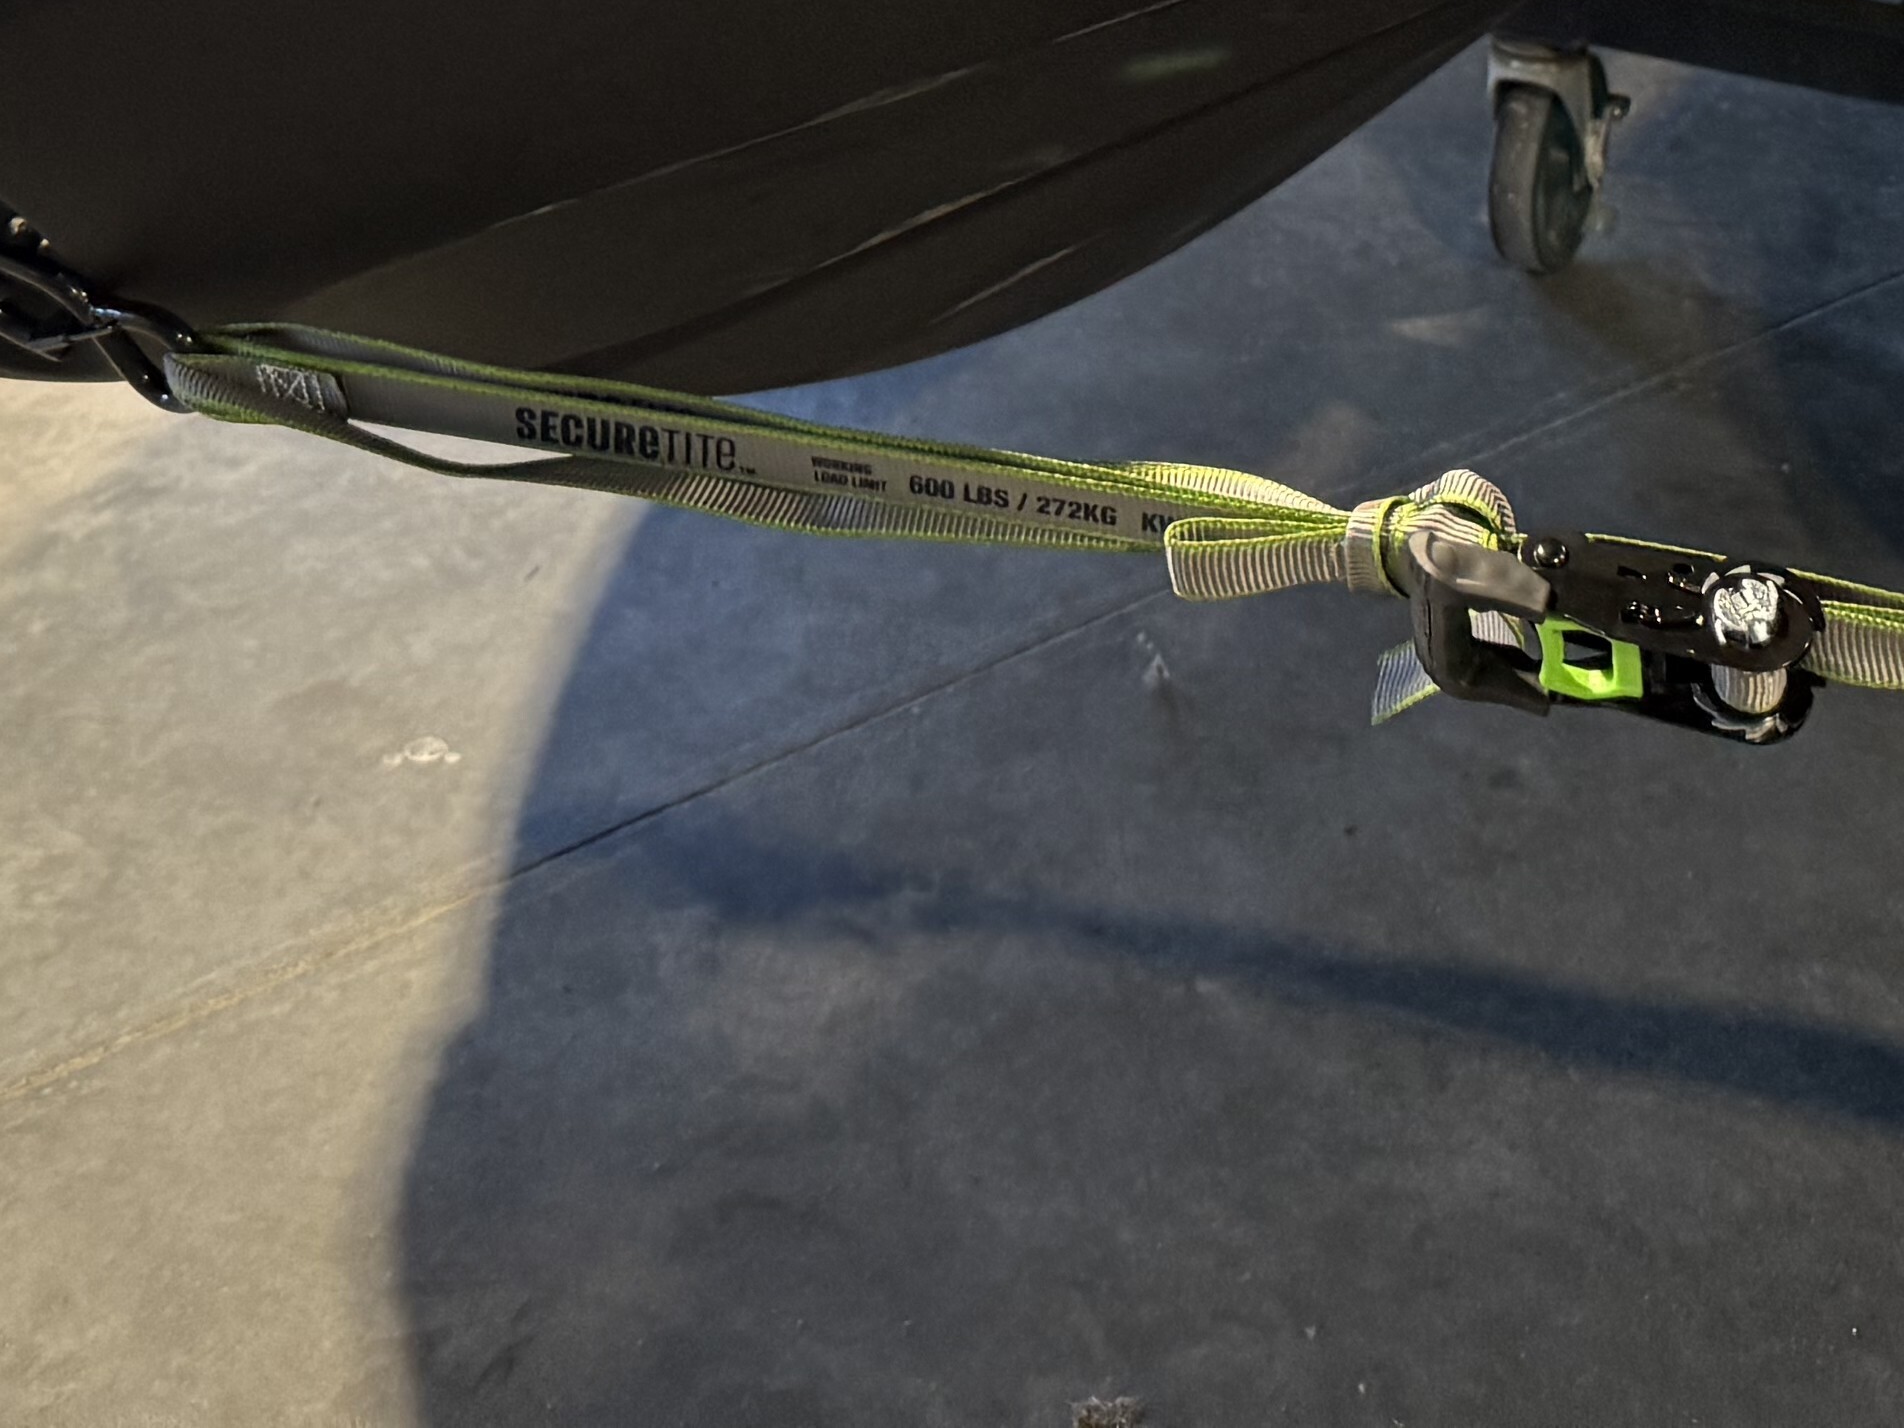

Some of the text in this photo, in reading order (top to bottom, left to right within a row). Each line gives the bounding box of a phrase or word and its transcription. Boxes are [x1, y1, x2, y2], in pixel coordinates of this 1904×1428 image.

[811, 456, 873, 476] WORKING
[813, 471, 889, 493] LOAD LIMIT
[908, 474, 956, 499] 600
[963, 482, 1010, 509] LBS
[1016, 490, 1028, 512] /
[1035, 495, 1119, 528] 272KG
